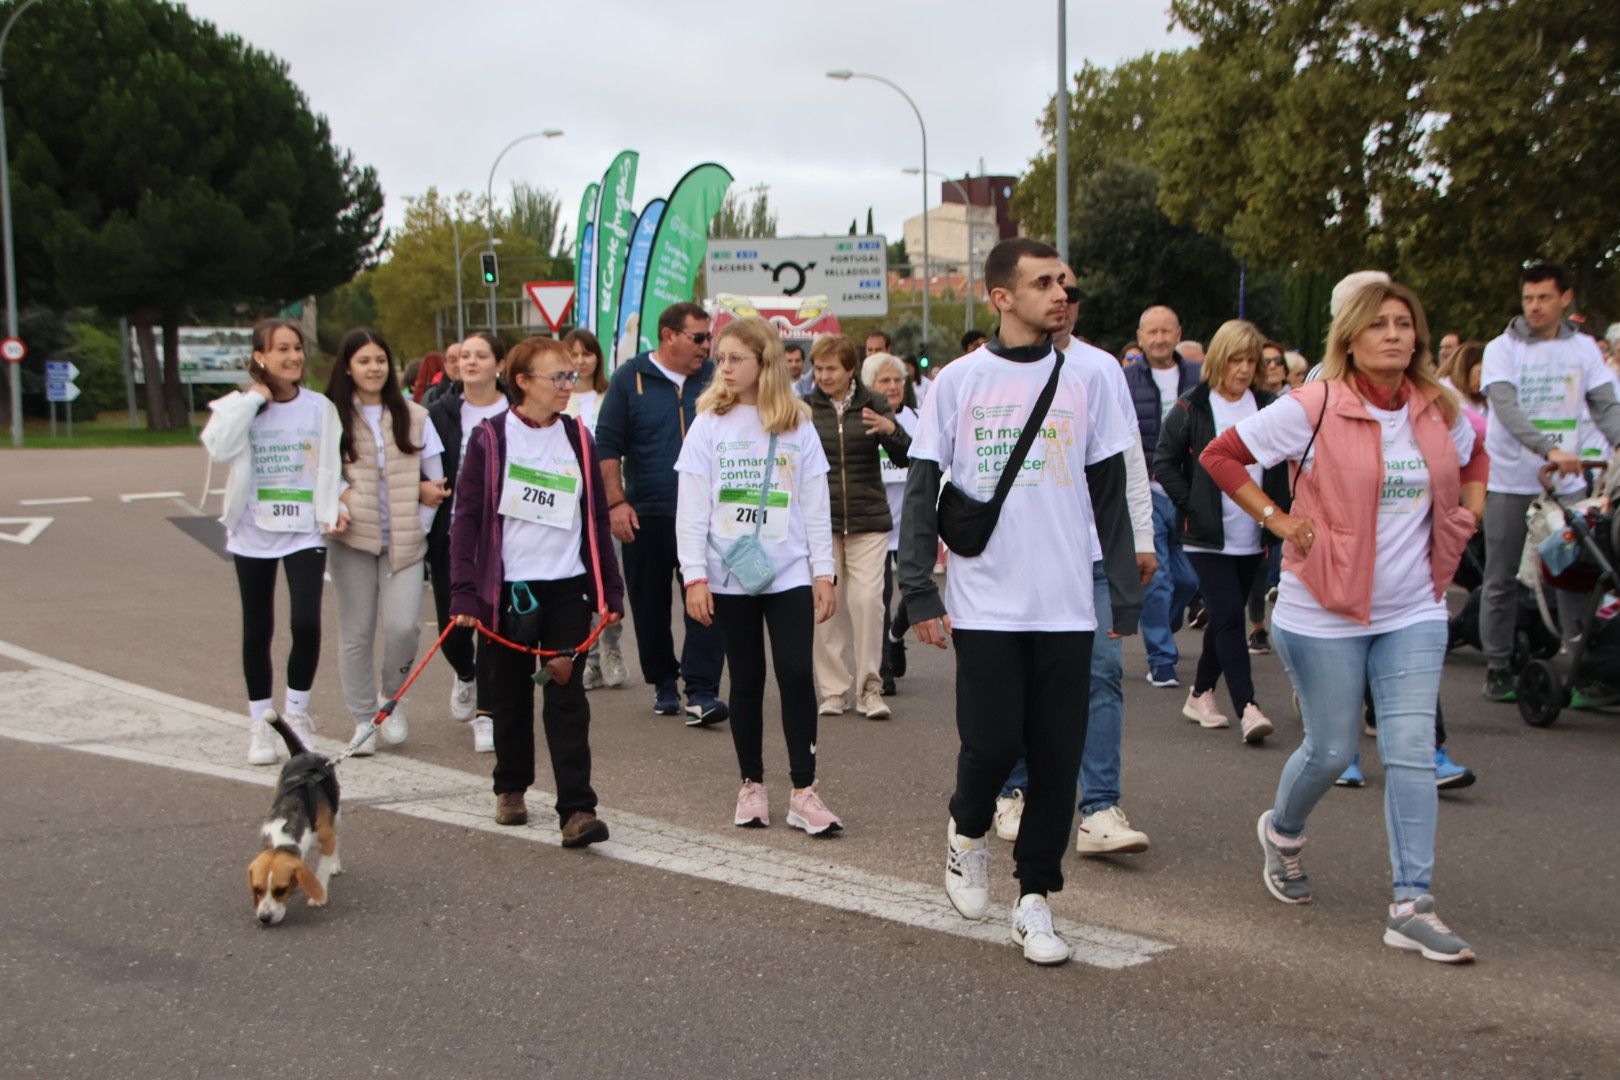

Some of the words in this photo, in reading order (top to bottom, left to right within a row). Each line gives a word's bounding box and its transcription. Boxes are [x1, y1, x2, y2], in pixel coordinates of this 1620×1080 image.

[604, 156, 632, 238] Inglés
[602, 236, 619, 290] Corte
[831, 254, 879, 263] PORTUGAL
[825, 267, 881, 276] VALLADOLID
[842, 293, 881, 301] ZAMORA
[975, 427, 993, 441] En
[269, 441, 312, 452] marcha
[976, 442, 1017, 457] contr
[720, 457, 735, 468] En
[978, 459, 989, 473] el
[256, 464, 265, 474] el
[720, 469, 761, 480] contra
[522, 486, 556, 508] 2764
[272, 503, 301, 517] 3701
